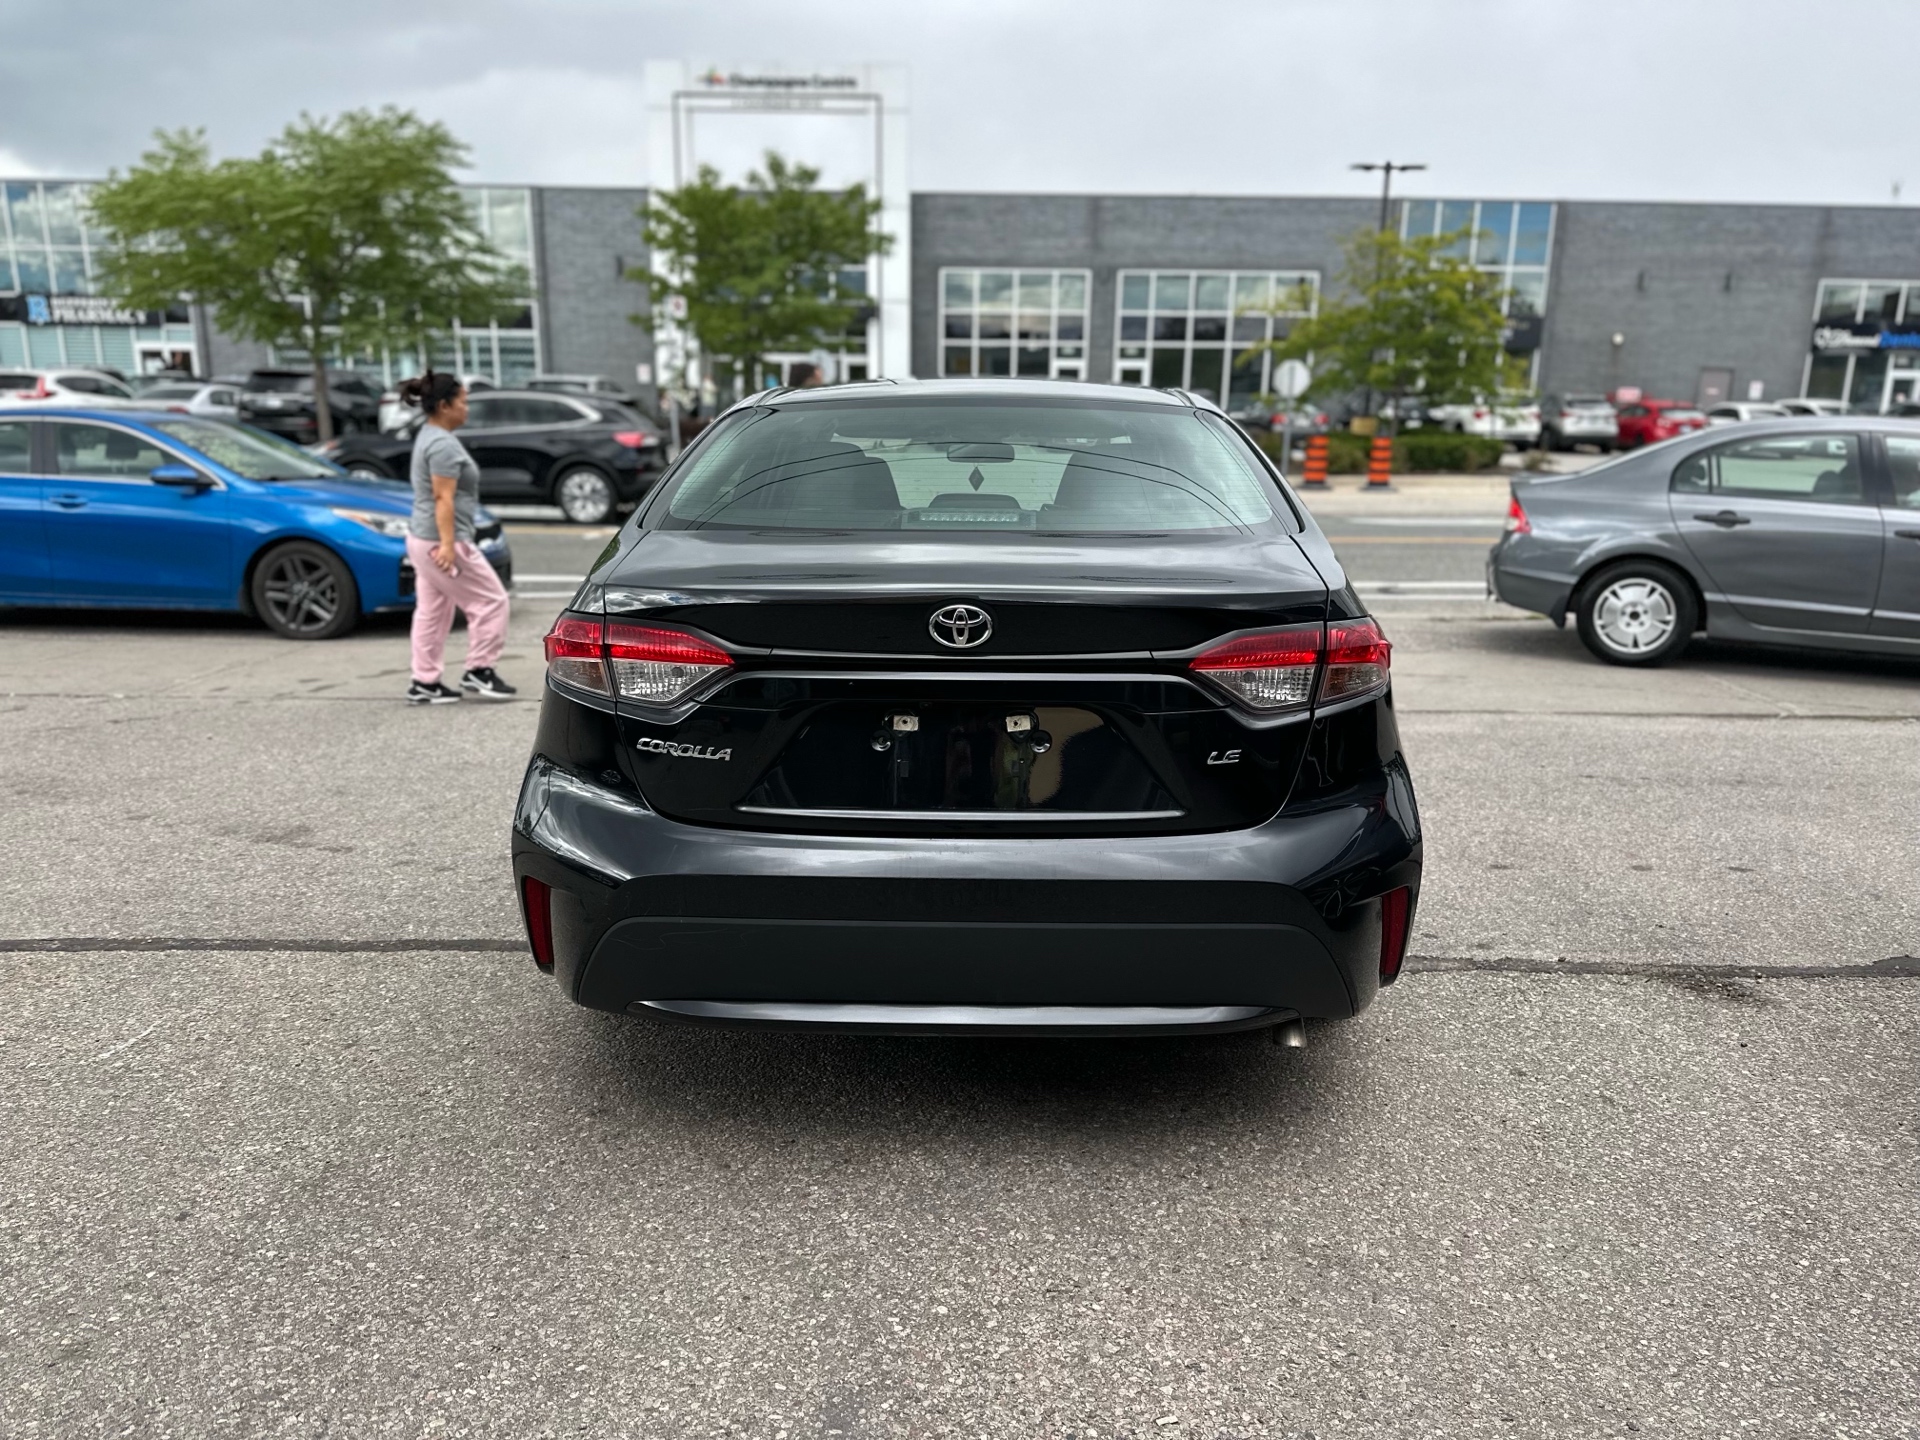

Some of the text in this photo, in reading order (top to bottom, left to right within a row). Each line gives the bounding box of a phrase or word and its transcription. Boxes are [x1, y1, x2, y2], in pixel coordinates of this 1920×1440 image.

[52, 308, 147, 324] PHARMACY
[636, 737, 733, 762] COROLLA
[1207, 749, 1242, 765] LE
